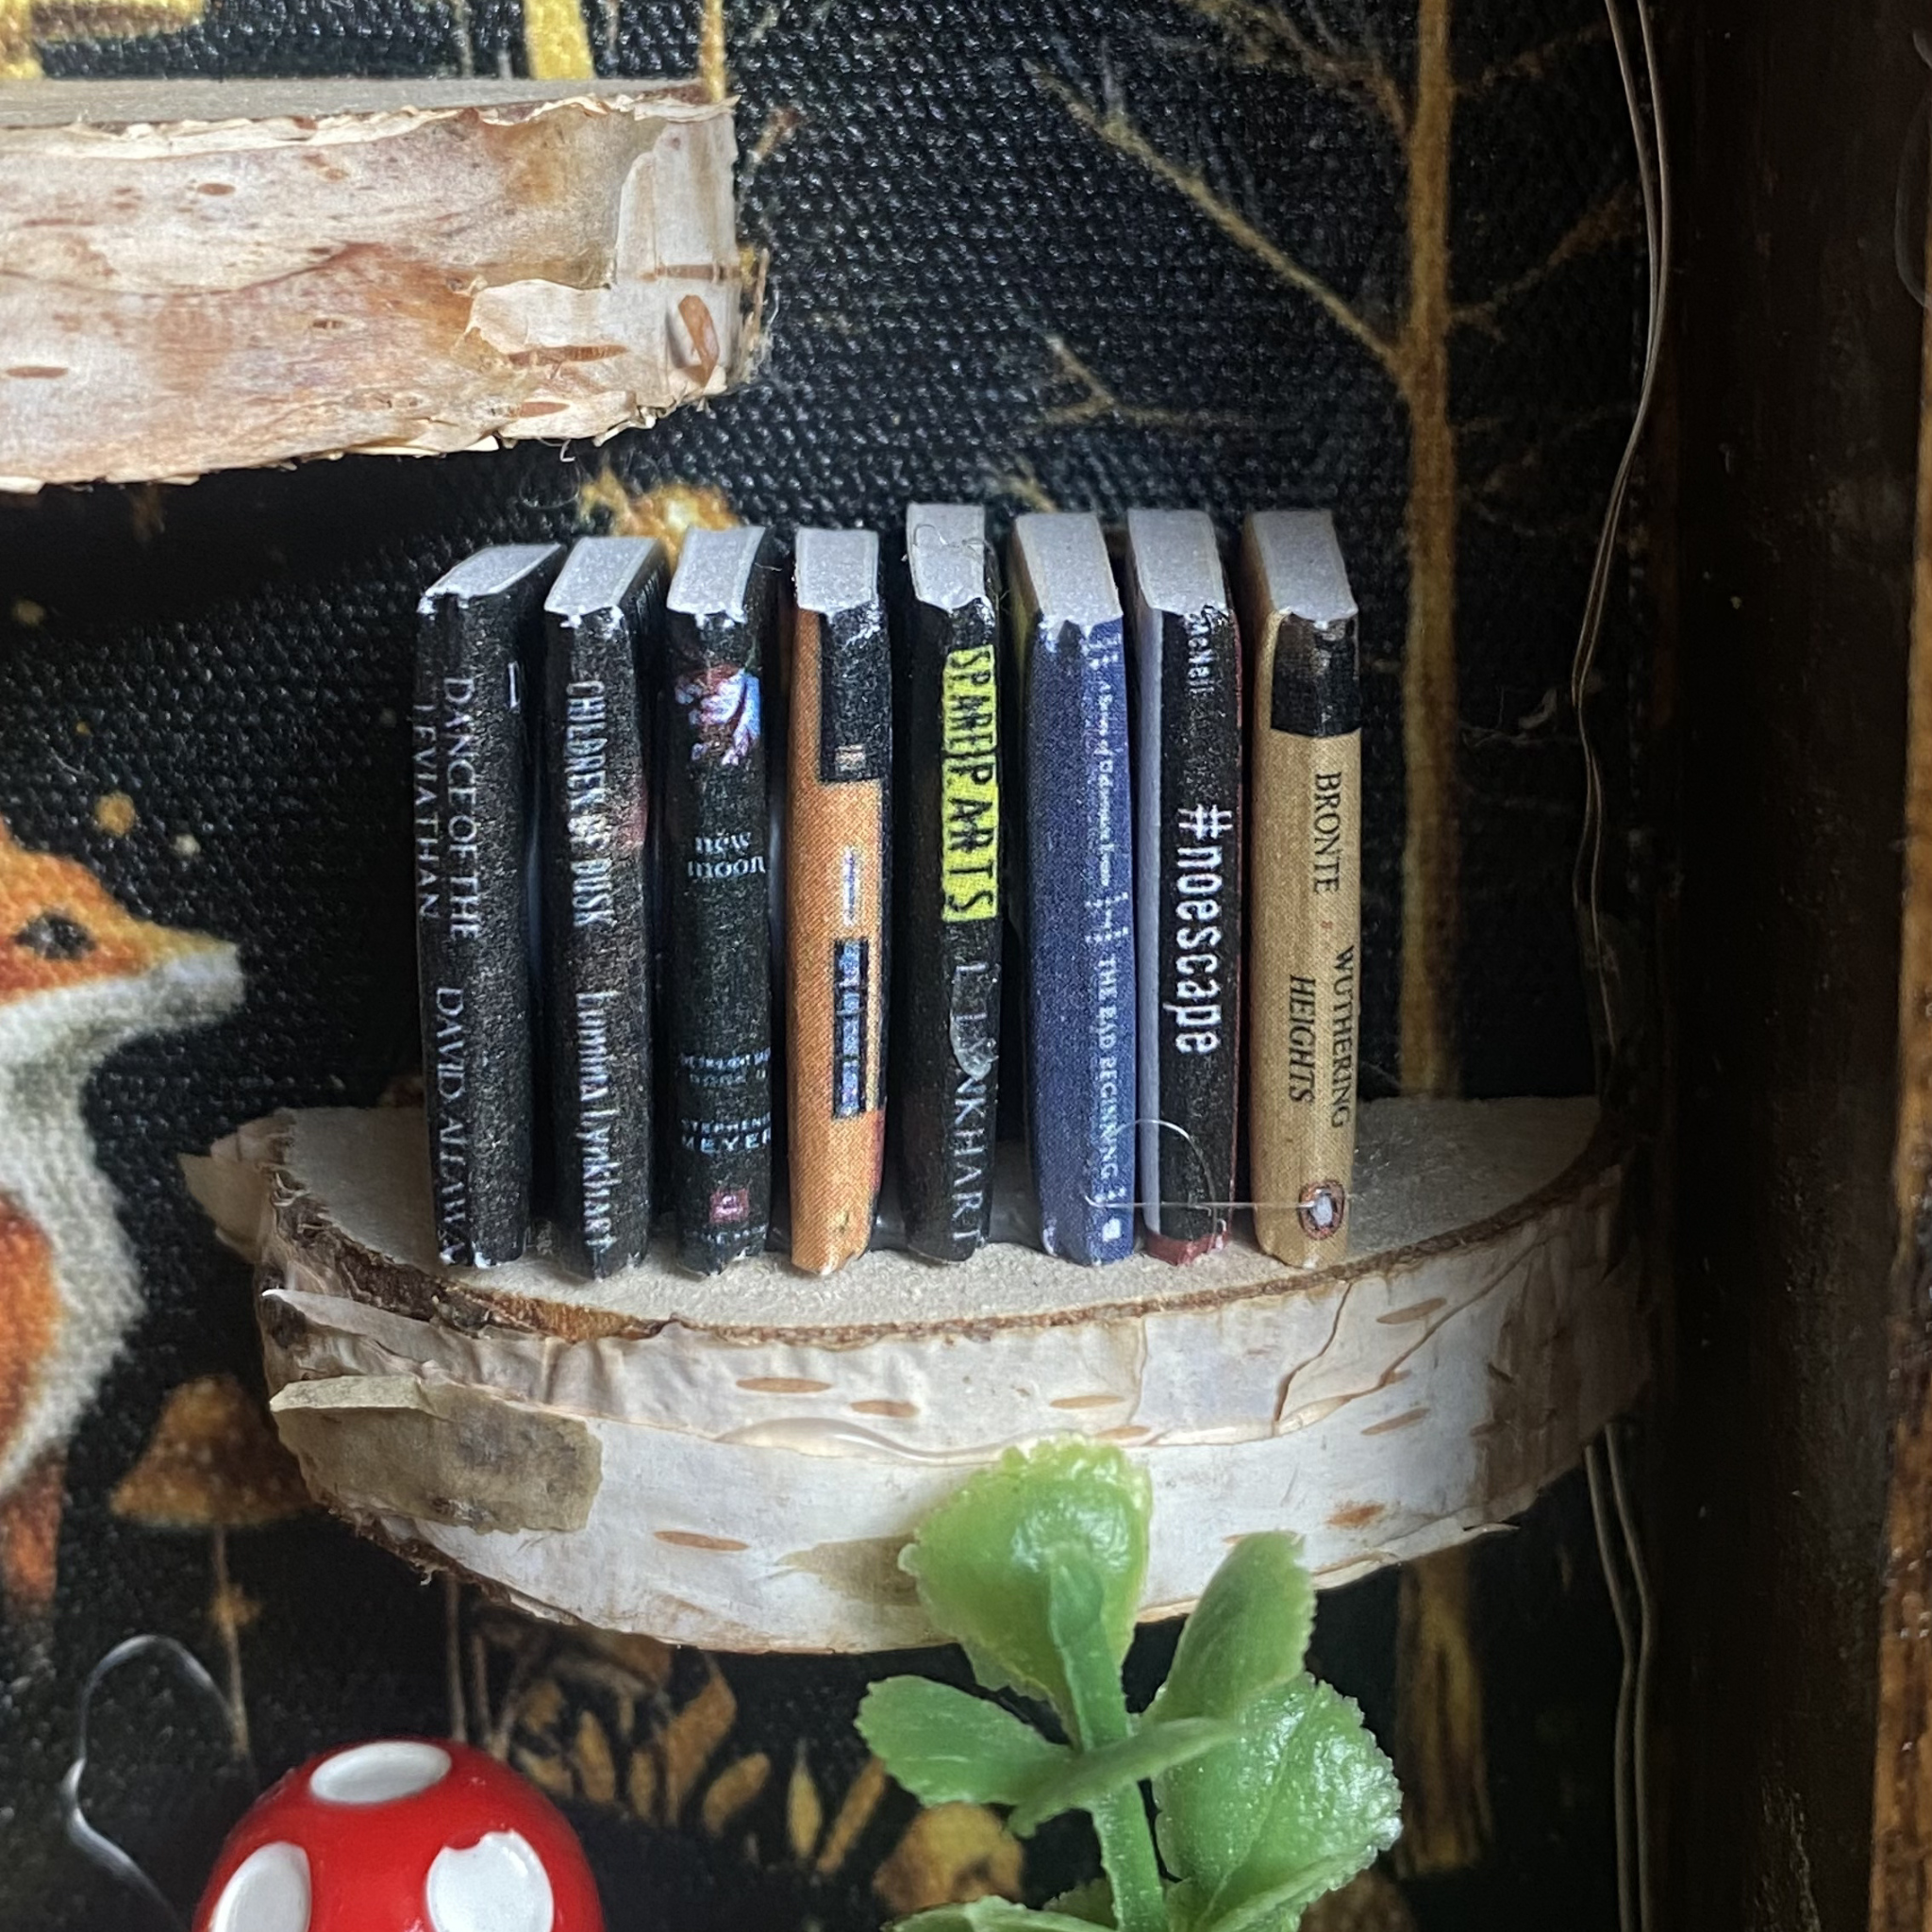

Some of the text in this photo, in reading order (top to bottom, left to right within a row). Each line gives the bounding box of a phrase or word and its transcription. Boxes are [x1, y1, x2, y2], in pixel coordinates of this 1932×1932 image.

[443, 675, 481, 941] DANCE OF THE
[565, 679, 608, 810] CHILDREN
[413, 704, 441, 920] LEVIATHAN
[687, 856, 766, 878] moon
[694, 831, 752, 856] new
[946, 760, 995, 913] PARTS
[570, 858, 615, 927] DUSK
[1162, 804, 1233, 1054] #noescape
[1097, 953, 1118, 1000] THE
[1289, 974, 1316, 1104] HEIGHTS
[1331, 945, 1355, 1129] WUTHERING
[436, 987, 465, 1103] DAVID
[1098, 1056, 1119, 1179] BEGINNING
